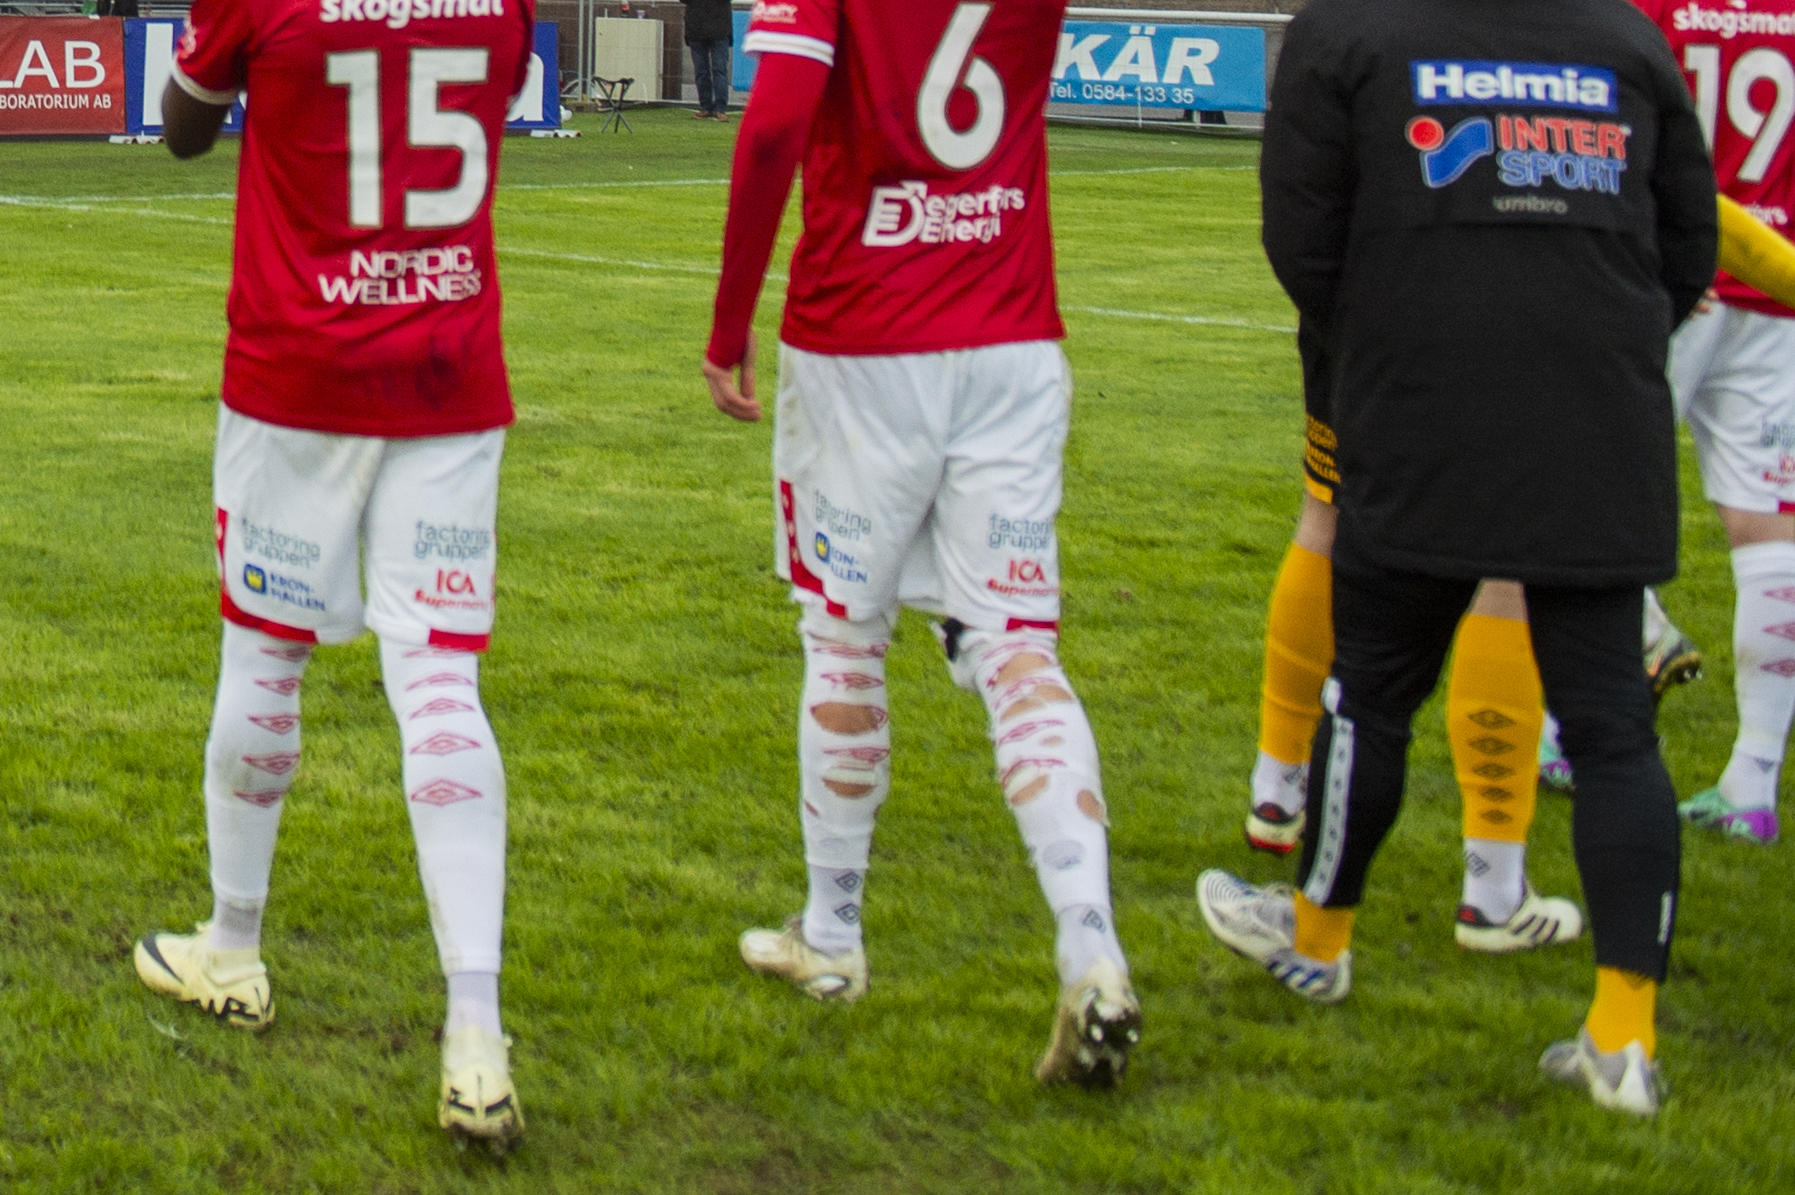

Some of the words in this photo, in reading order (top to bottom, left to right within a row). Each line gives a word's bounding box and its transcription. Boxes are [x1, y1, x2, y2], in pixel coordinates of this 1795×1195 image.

[92, 93, 112, 109] AB
[916, 2, 1006, 170] 6
[1081, 83, 1167, 103] 0584-133
[1171, 87, 1195, 104] 35
[1416, 62, 1610, 107] Helmia
[1684, 44, 1795, 183] 19
[325, 46, 491, 230] 15
[1495, 113, 1627, 161] INTER
[1496, 150, 1627, 196] SPORT
[350, 244, 474, 278] NORDIC
[241, 518, 320, 563] factoring
[269, 572, 315, 594] KRON-
[436, 568, 476, 596] ICA
[1008, 558, 1047, 584] ICA
[270, 587, 326, 612] HALLEN
